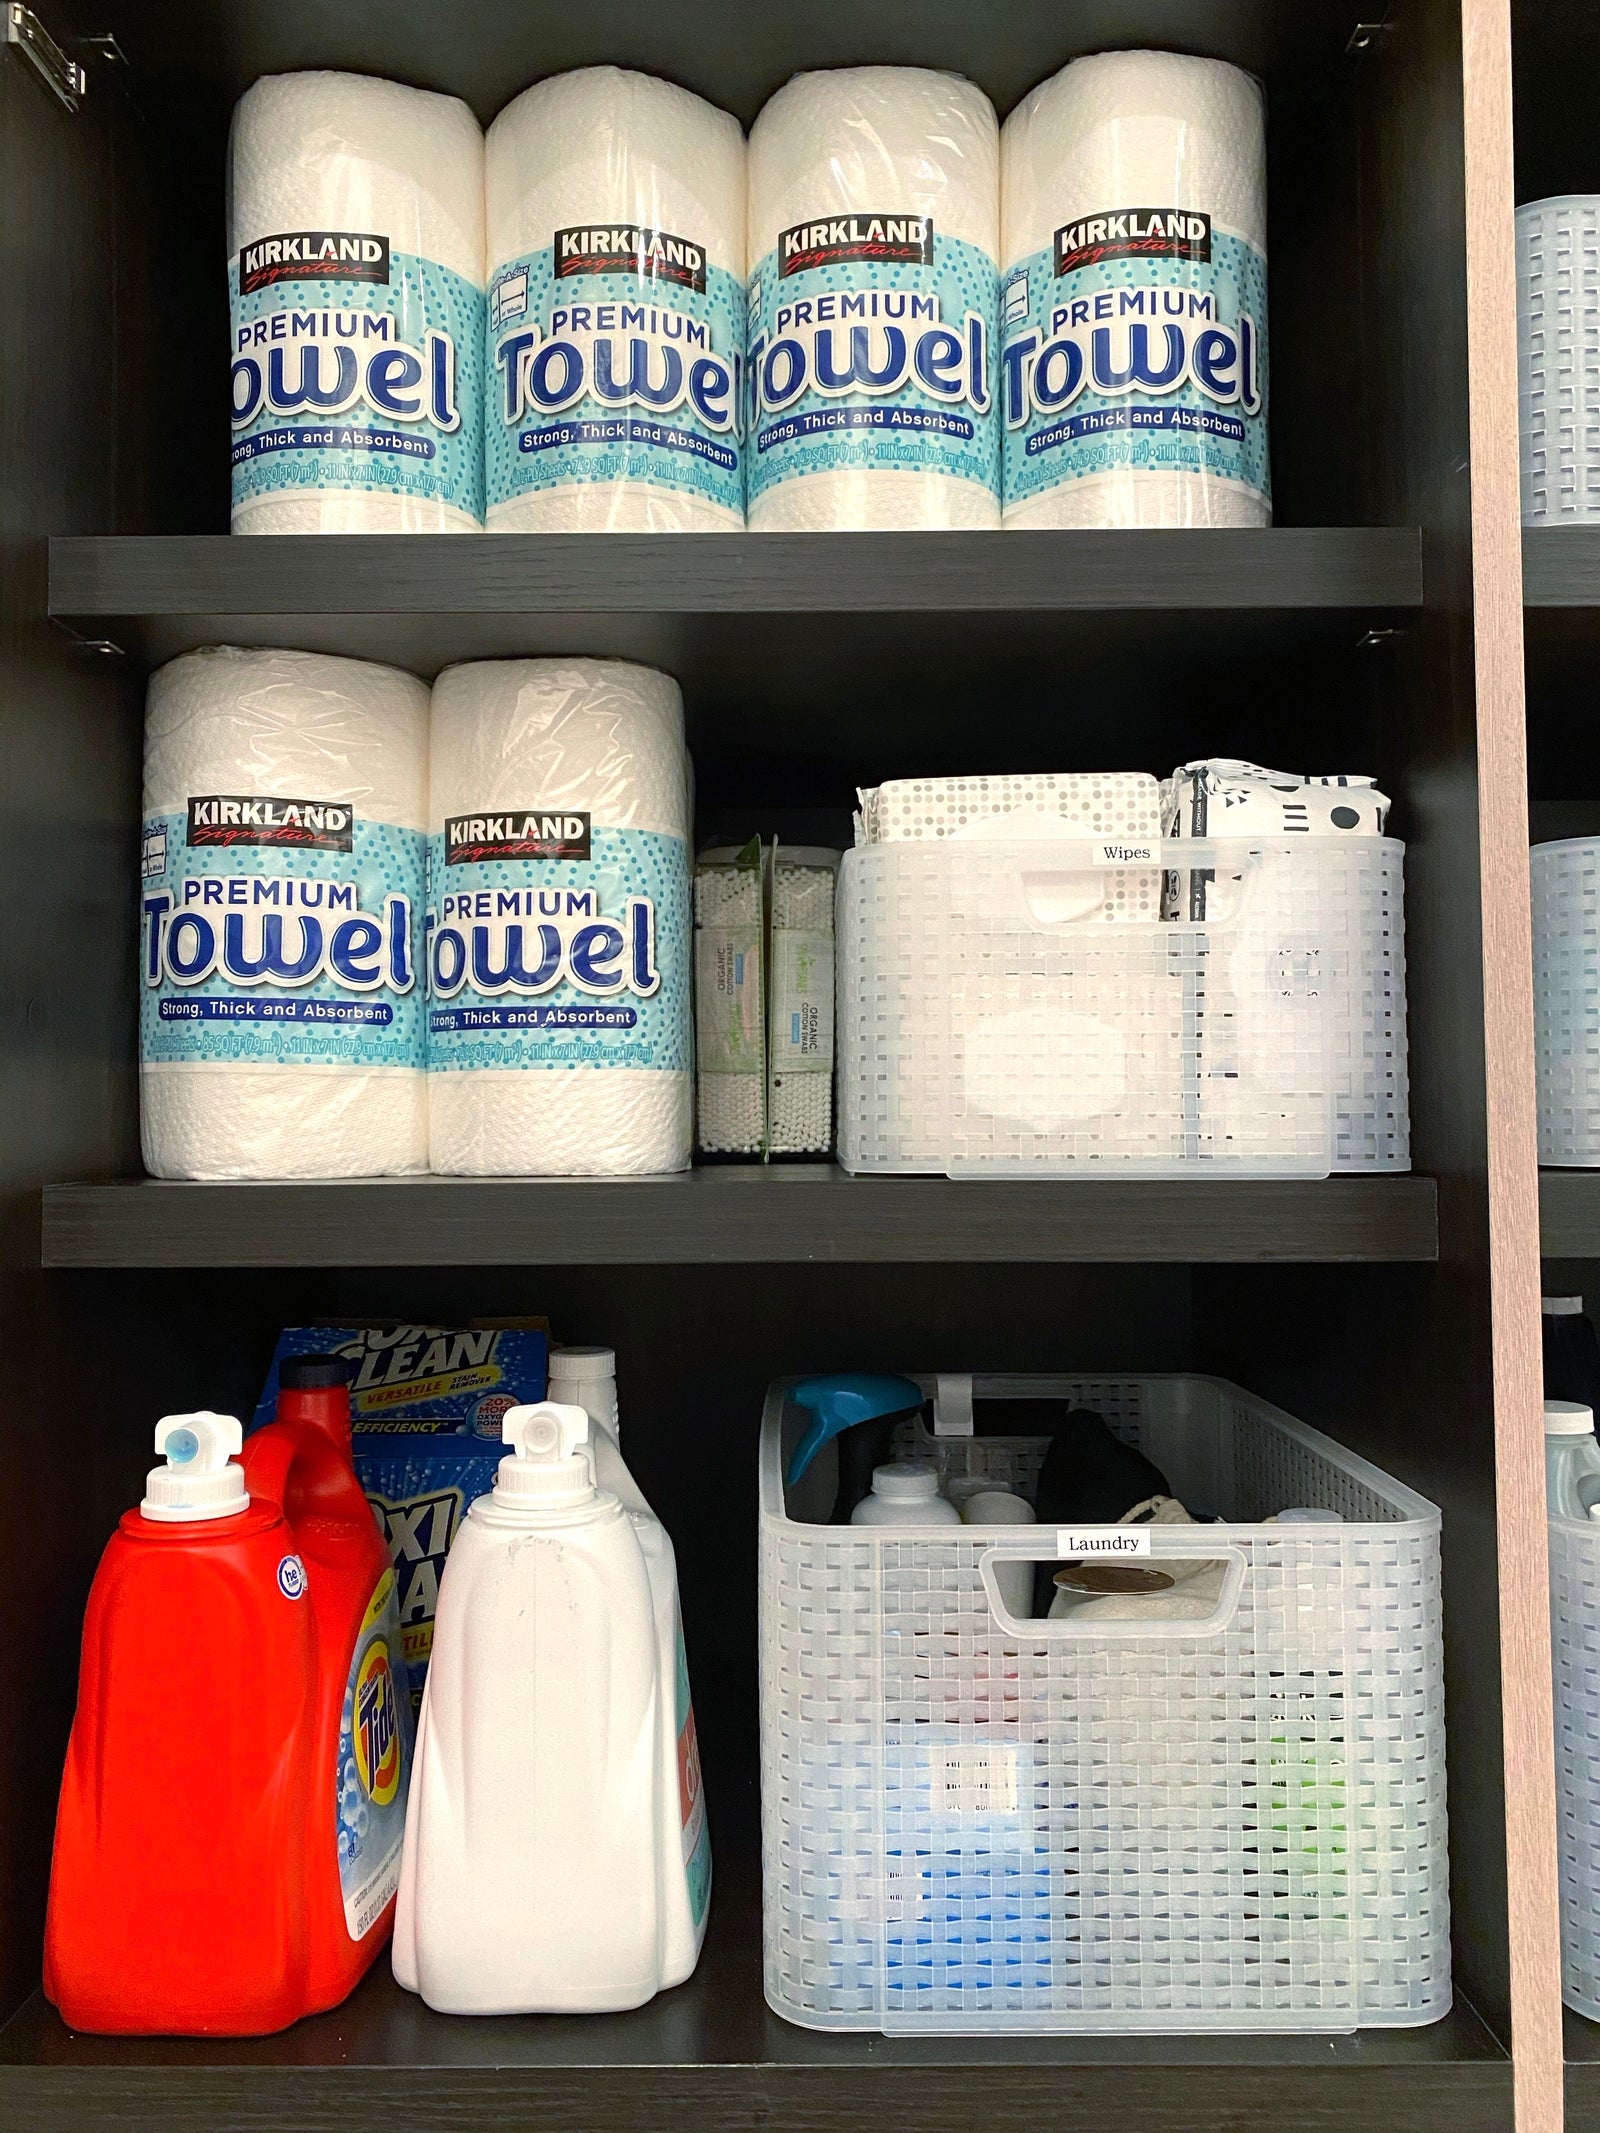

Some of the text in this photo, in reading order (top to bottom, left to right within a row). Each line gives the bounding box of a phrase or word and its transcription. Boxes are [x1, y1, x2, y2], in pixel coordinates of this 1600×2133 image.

[562, 230, 702, 271] KIRKLAND
[785, 219, 927, 257] KIRKLAND
[1061, 214, 1206, 255] KIRKLAND
[246, 237, 383, 274] KIRKLAND
[786, 244, 923, 276] Signature
[1061, 238, 1207, 273] Signature
[246, 261, 383, 292] Signature
[552, 305, 705, 349] PREMIUM
[777, 293, 934, 335] PREMIUM
[1053, 291, 1211, 336] PREMIUM
[239, 312, 388, 352] PREMIUM
[231, 335, 454, 424] owel
[1003, 318, 1257, 422] Towel
[524, 423, 733, 465] Strong, Thick and Absorbent
[760, 410, 969, 448] Strong, Thick and Absorbent
[1030, 410, 1243, 451] Strong, Thick and Absorbent
[231, 430, 429, 461] rong, Thick and Absorbent
[194, 801, 350, 831] KIRKLAND
[450, 817, 584, 845] KIRKLAND
[193, 825, 345, 848] Signature
[449, 840, 584, 864] Signature
[1104, 847, 1150, 860] Wipes
[185, 879, 352, 911] PREMIUM
[443, 892, 591, 921] PREMIUM
[145, 896, 411, 986] Towel
[717, 947, 725, 991] ORGANIC
[162, 1001, 387, 1020] Strong, Thick and Absorbent
[463, 1012, 501, 1024] Thick
[507, 1010, 538, 1023] and
[544, 1010, 631, 1025] Absorbent
[801, 1031, 809, 1054] SWABS
[810, 1007, 818, 1050] ORGANIC
[303, 1038, 314, 1053] IN
[328, 1039, 340, 1054] IN
[530, 1044, 540, 1060] 11
[541, 1044, 552, 1060] IN
[566, 1044, 578, 1060] IN
[368, 1381, 442, 1404] VERSATILE
[450, 1376, 491, 1391] REMOVER
[452, 1373, 478, 1383] STAIN
[486, 1397, 516, 1406] 20%
[370, 1499, 452, 1561] XI
[1069, 1536, 1139, 1552] Laundry
[285, 1570, 297, 1583] he
[359, 1670, 396, 1800] Tide
